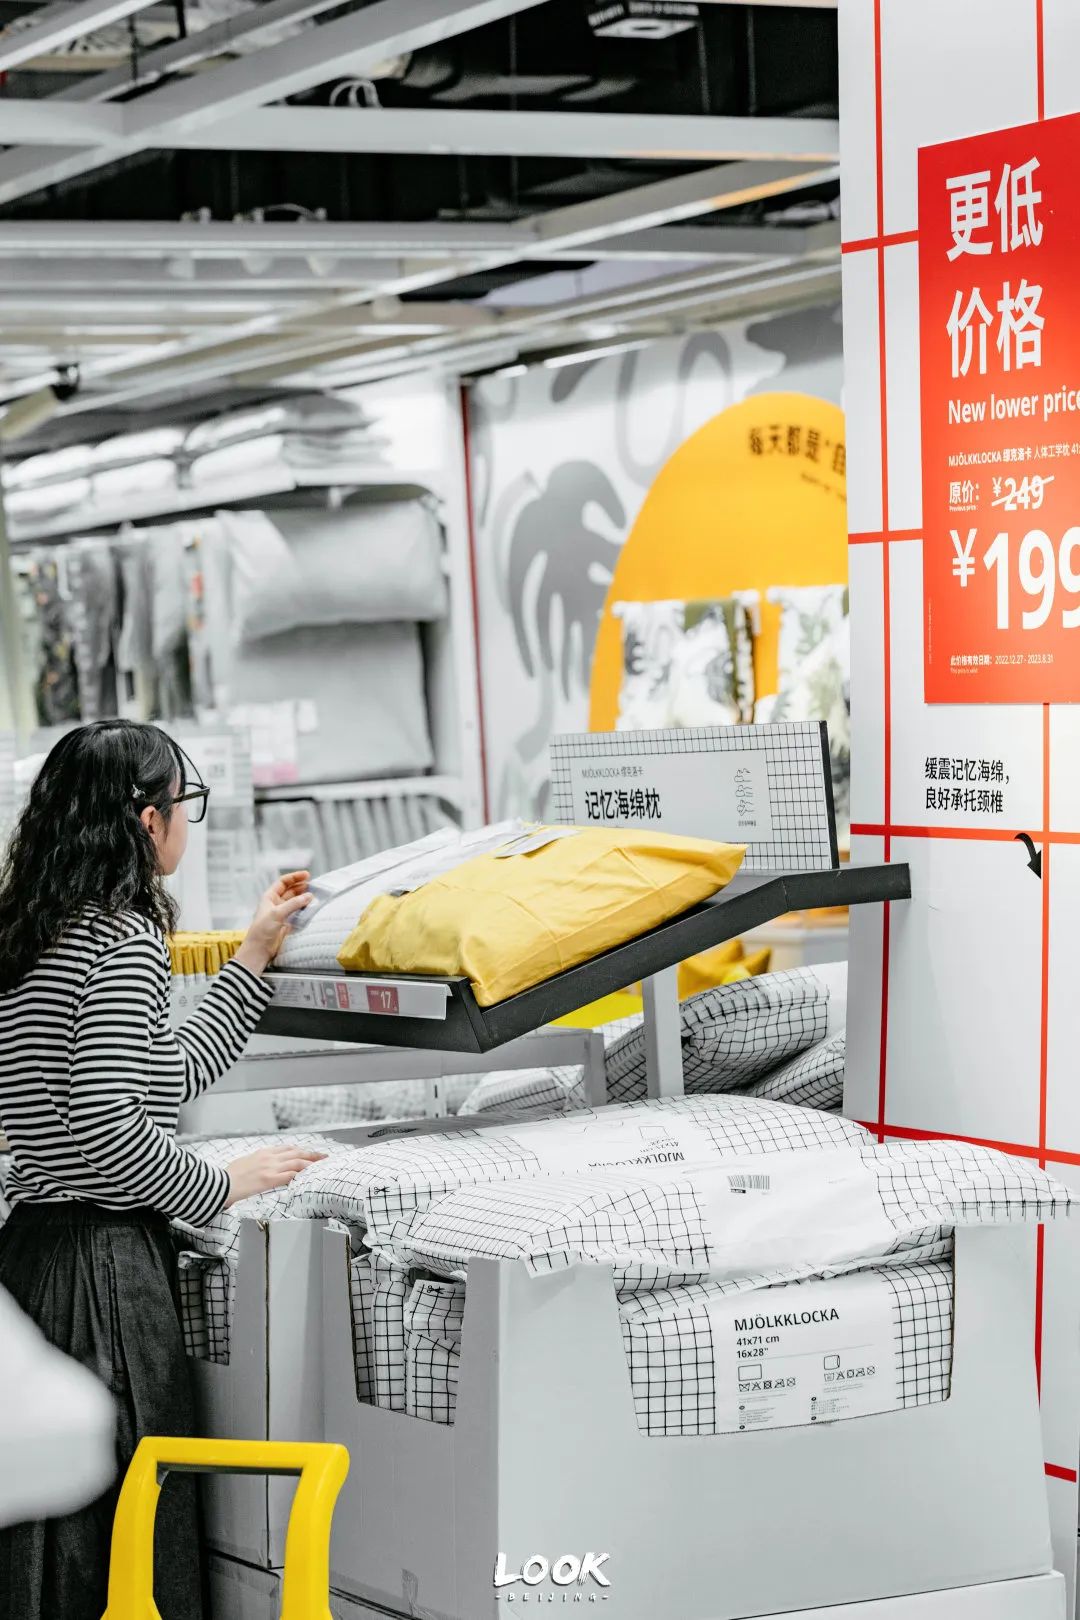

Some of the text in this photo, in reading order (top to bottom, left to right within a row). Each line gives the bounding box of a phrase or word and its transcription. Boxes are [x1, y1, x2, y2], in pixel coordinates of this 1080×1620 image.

[946, 156, 1044, 262] 更低
[946, 278, 1045, 378] 价格
[948, 399, 986, 424] New
[991, 393, 1039, 420] lower
[948, 452, 1001, 467] MJÖLKKLOCKA
[585, 788, 662, 820] 记忆海绵枕
[925, 786, 1004, 813] 良好承托颈椎
[380, 990, 391, 1009] 17
[734, 1308, 840, 1331] MJÖLKKLOCKA
[736, 1335, 780, 1346] 41x71 cm
[736, 1347, 769, 1358] 16x28"
